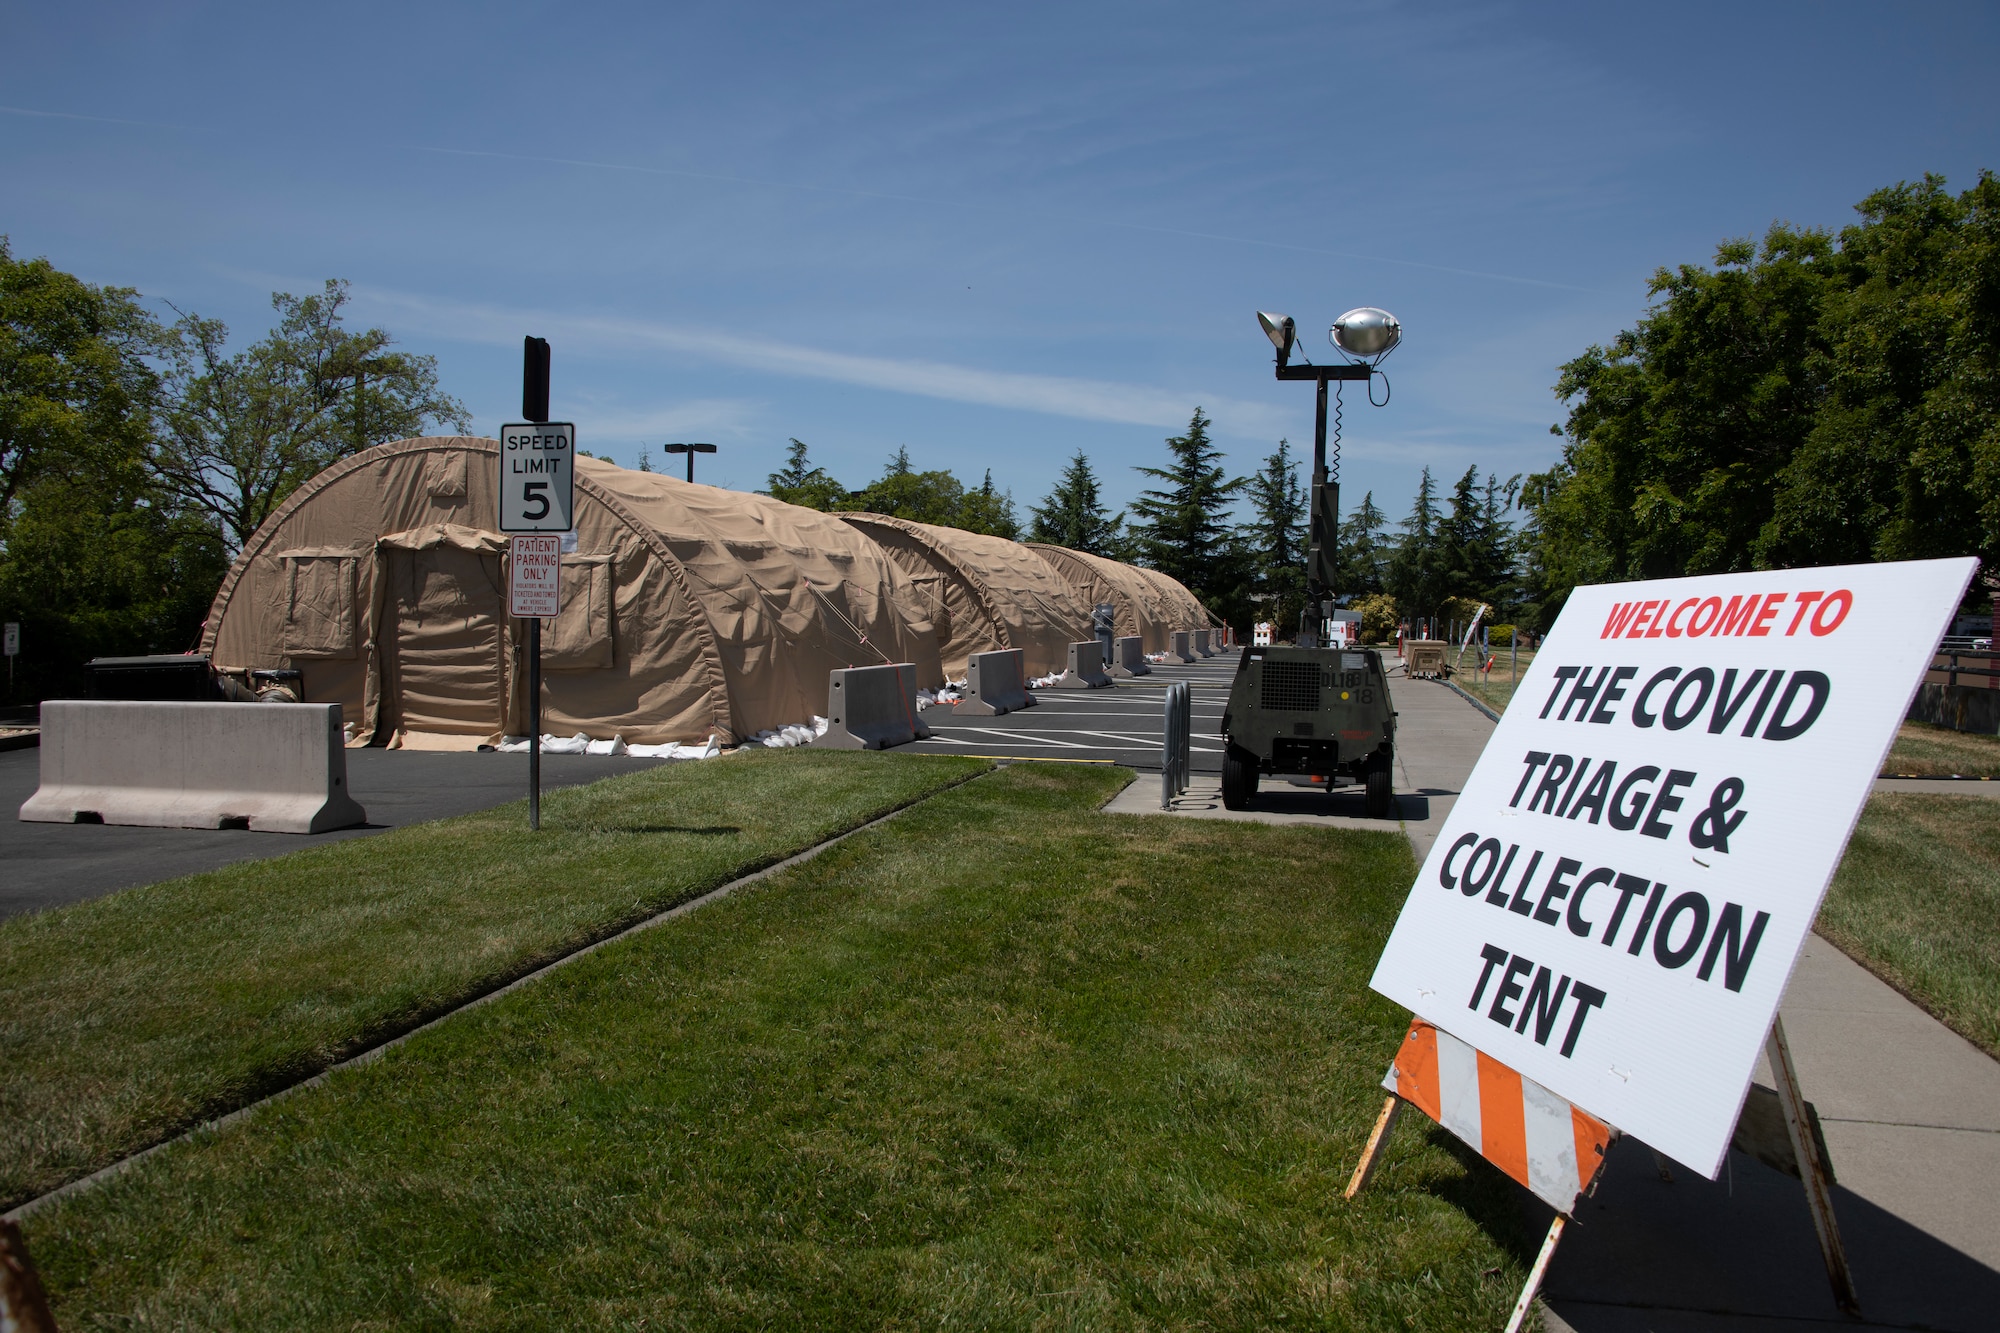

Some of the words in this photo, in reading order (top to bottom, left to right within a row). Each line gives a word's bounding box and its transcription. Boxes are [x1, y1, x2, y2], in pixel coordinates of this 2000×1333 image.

[507, 435, 568, 450] SPEED
[513, 458, 561, 474] LIMIT
[522, 482, 550, 520] 5
[518, 540, 556, 552] PATIENT
[516, 554, 557, 566] PARKING
[523, 568, 548, 580] ONLY
[1600, 592, 1788, 640] WELCOME
[1785, 589, 1854, 637] TO
[1353, 688, 1373, 704] 18
[1538, 666, 1640, 725] THE
[1631, 667, 1831, 742] COVID
[1508, 750, 1698, 840] TRIAGE
[1688, 776, 1748, 854] &
[1439, 832, 1771, 994] COLLECTION
[1467, 942, 1608, 1059] TENT
